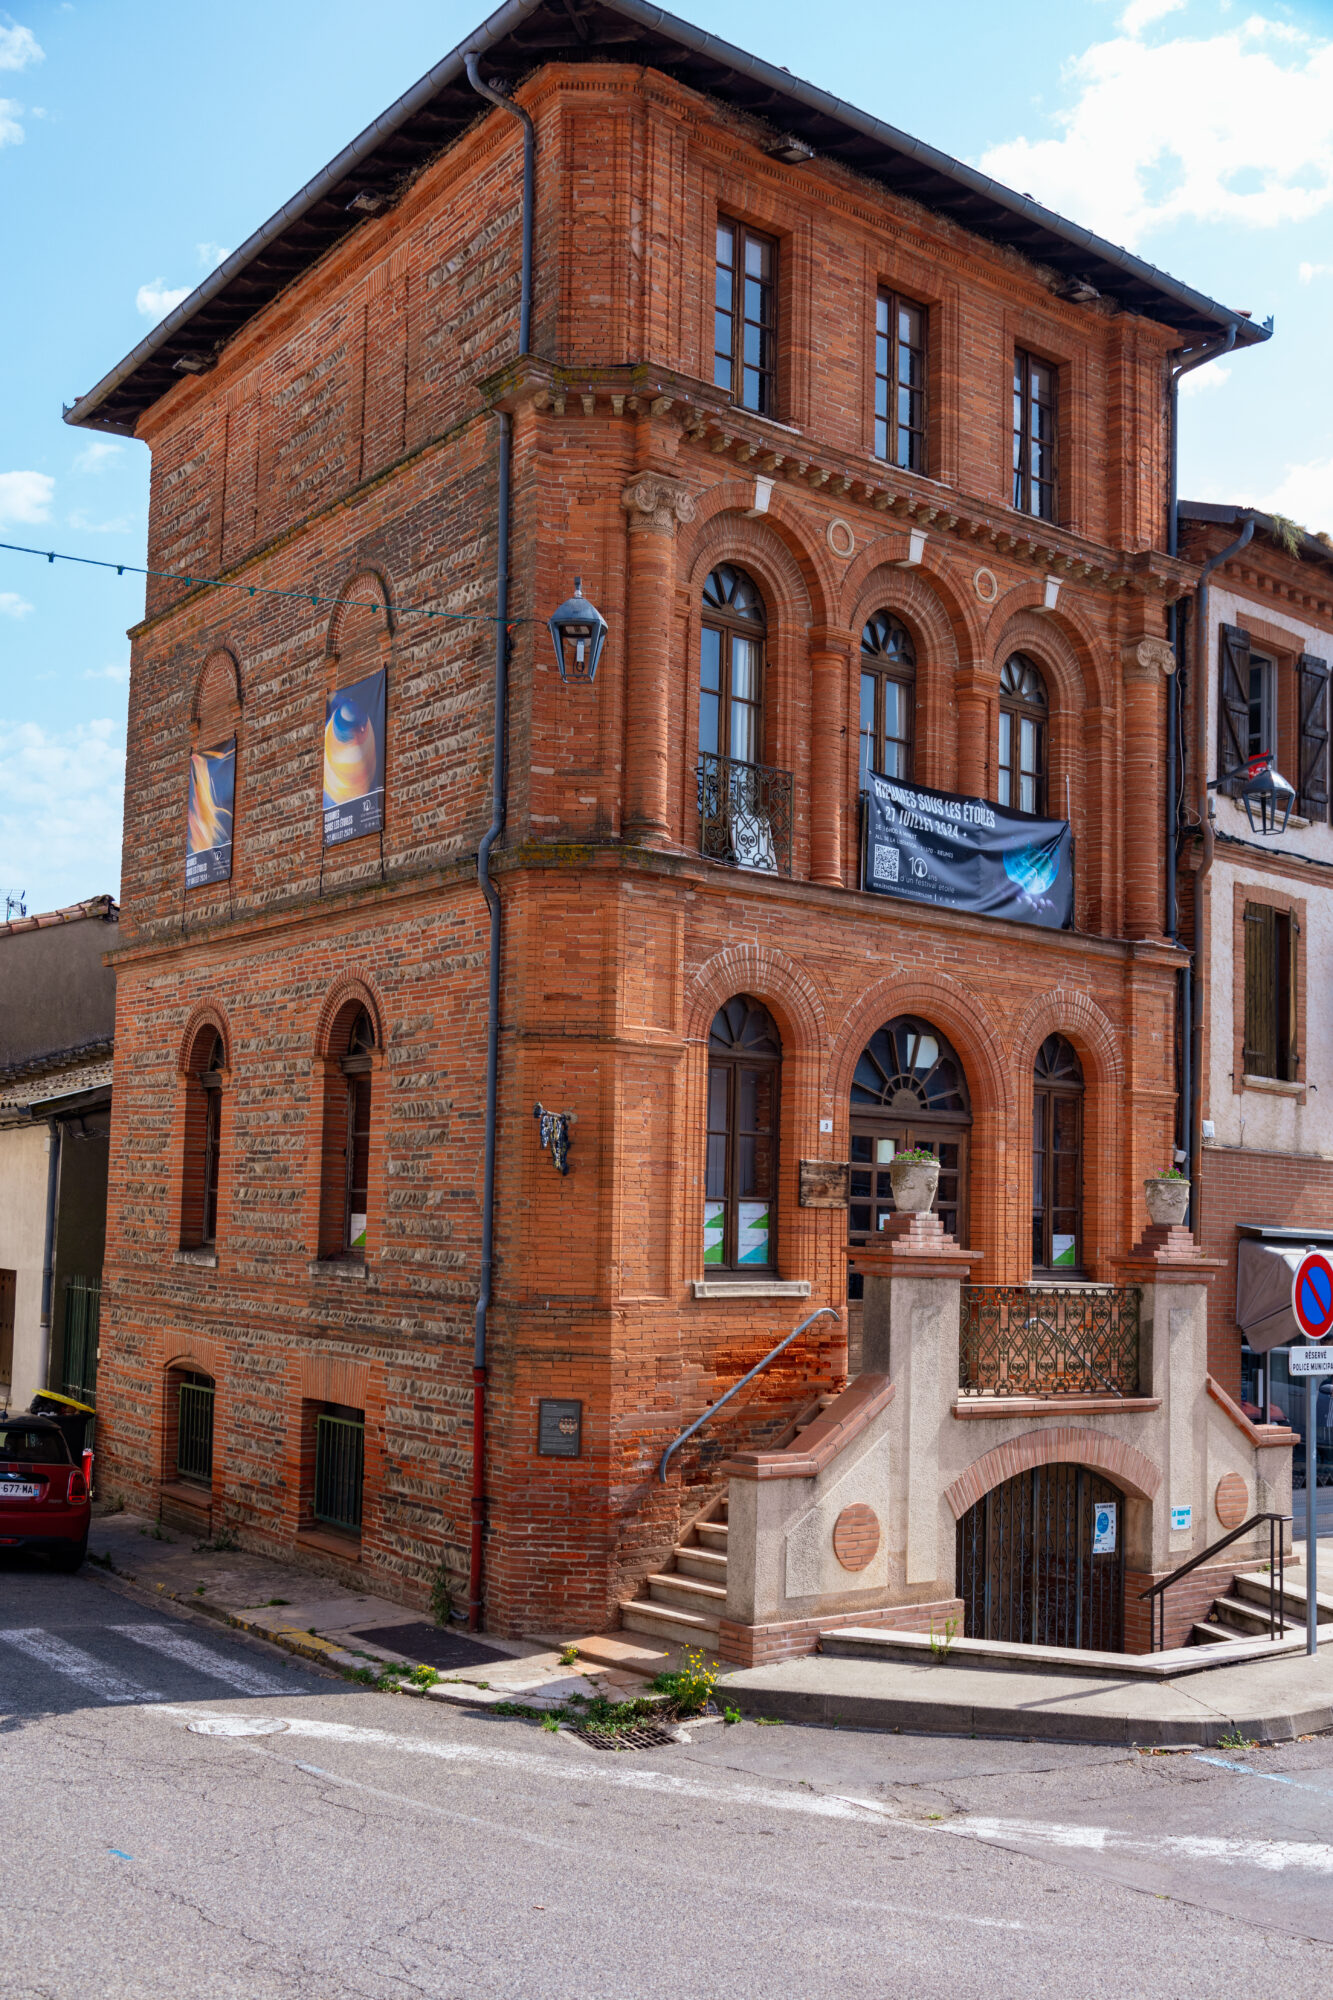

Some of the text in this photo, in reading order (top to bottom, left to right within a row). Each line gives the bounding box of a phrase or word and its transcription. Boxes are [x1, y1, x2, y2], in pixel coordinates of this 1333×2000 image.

[917, 793, 944, 816] SOUS
[944, 800, 961, 820] LES
[963, 801, 996, 828] ÉTOILES
[885, 806, 959, 839] 27 JUILLET 2024
[915, 878, 937, 889] festival
[1304, 1350, 1327, 1359] RÉSERVÉ
[1292, 1363, 1310, 1371] POLICE
